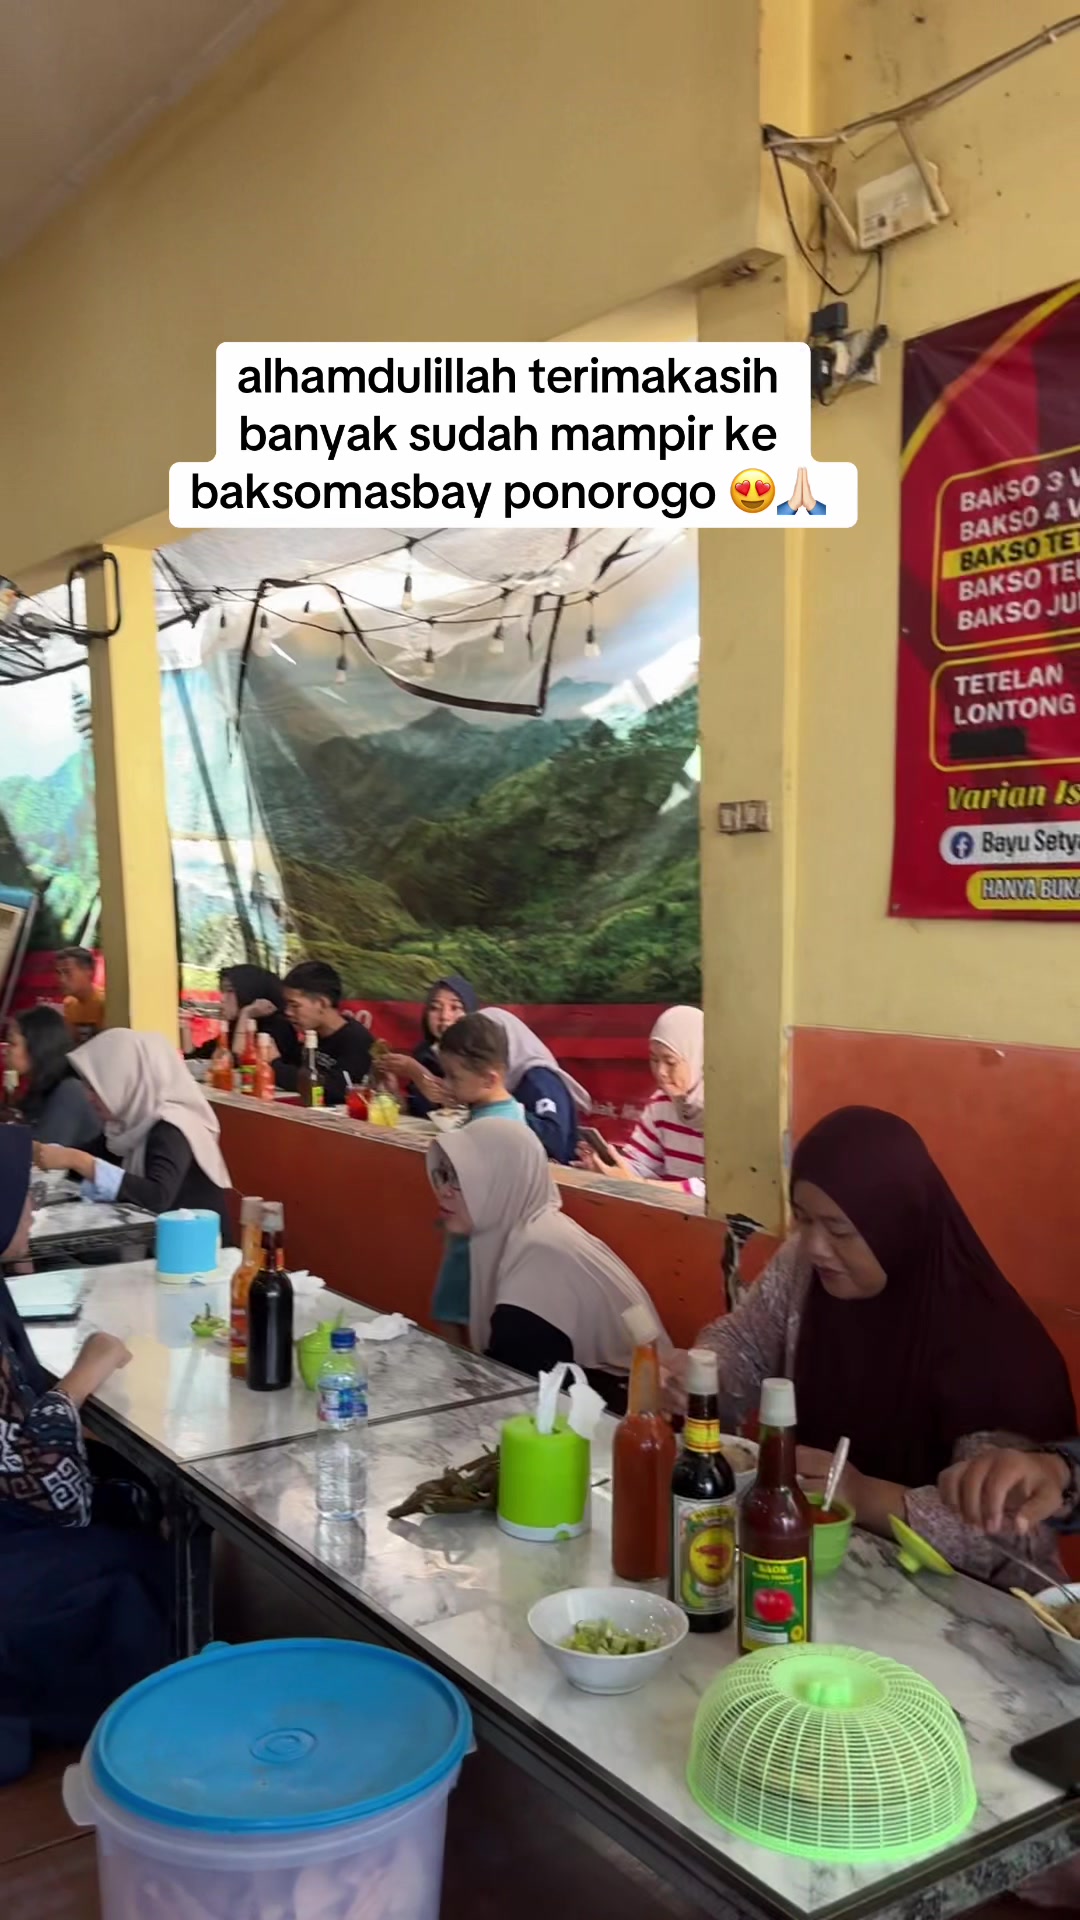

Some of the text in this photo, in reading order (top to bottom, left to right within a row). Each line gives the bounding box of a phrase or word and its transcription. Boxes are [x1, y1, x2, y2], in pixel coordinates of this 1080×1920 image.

[960, 475, 1041, 512] BAKSO
[1046, 470, 1064, 492] 3
[960, 506, 1040, 542] BAKSO
[1044, 501, 1061, 522] 4
[960, 537, 1041, 571] BAKSO
[959, 568, 1042, 601] BAKSO
[957, 591, 1080, 631] BAKSO JU
[953, 662, 1064, 697] TETELAN
[953, 693, 1076, 726] LONTONG
[947, 781, 1048, 811] Varian
[981, 831, 1031, 857] Bayu
[981, 877, 1037, 900] HANYA
